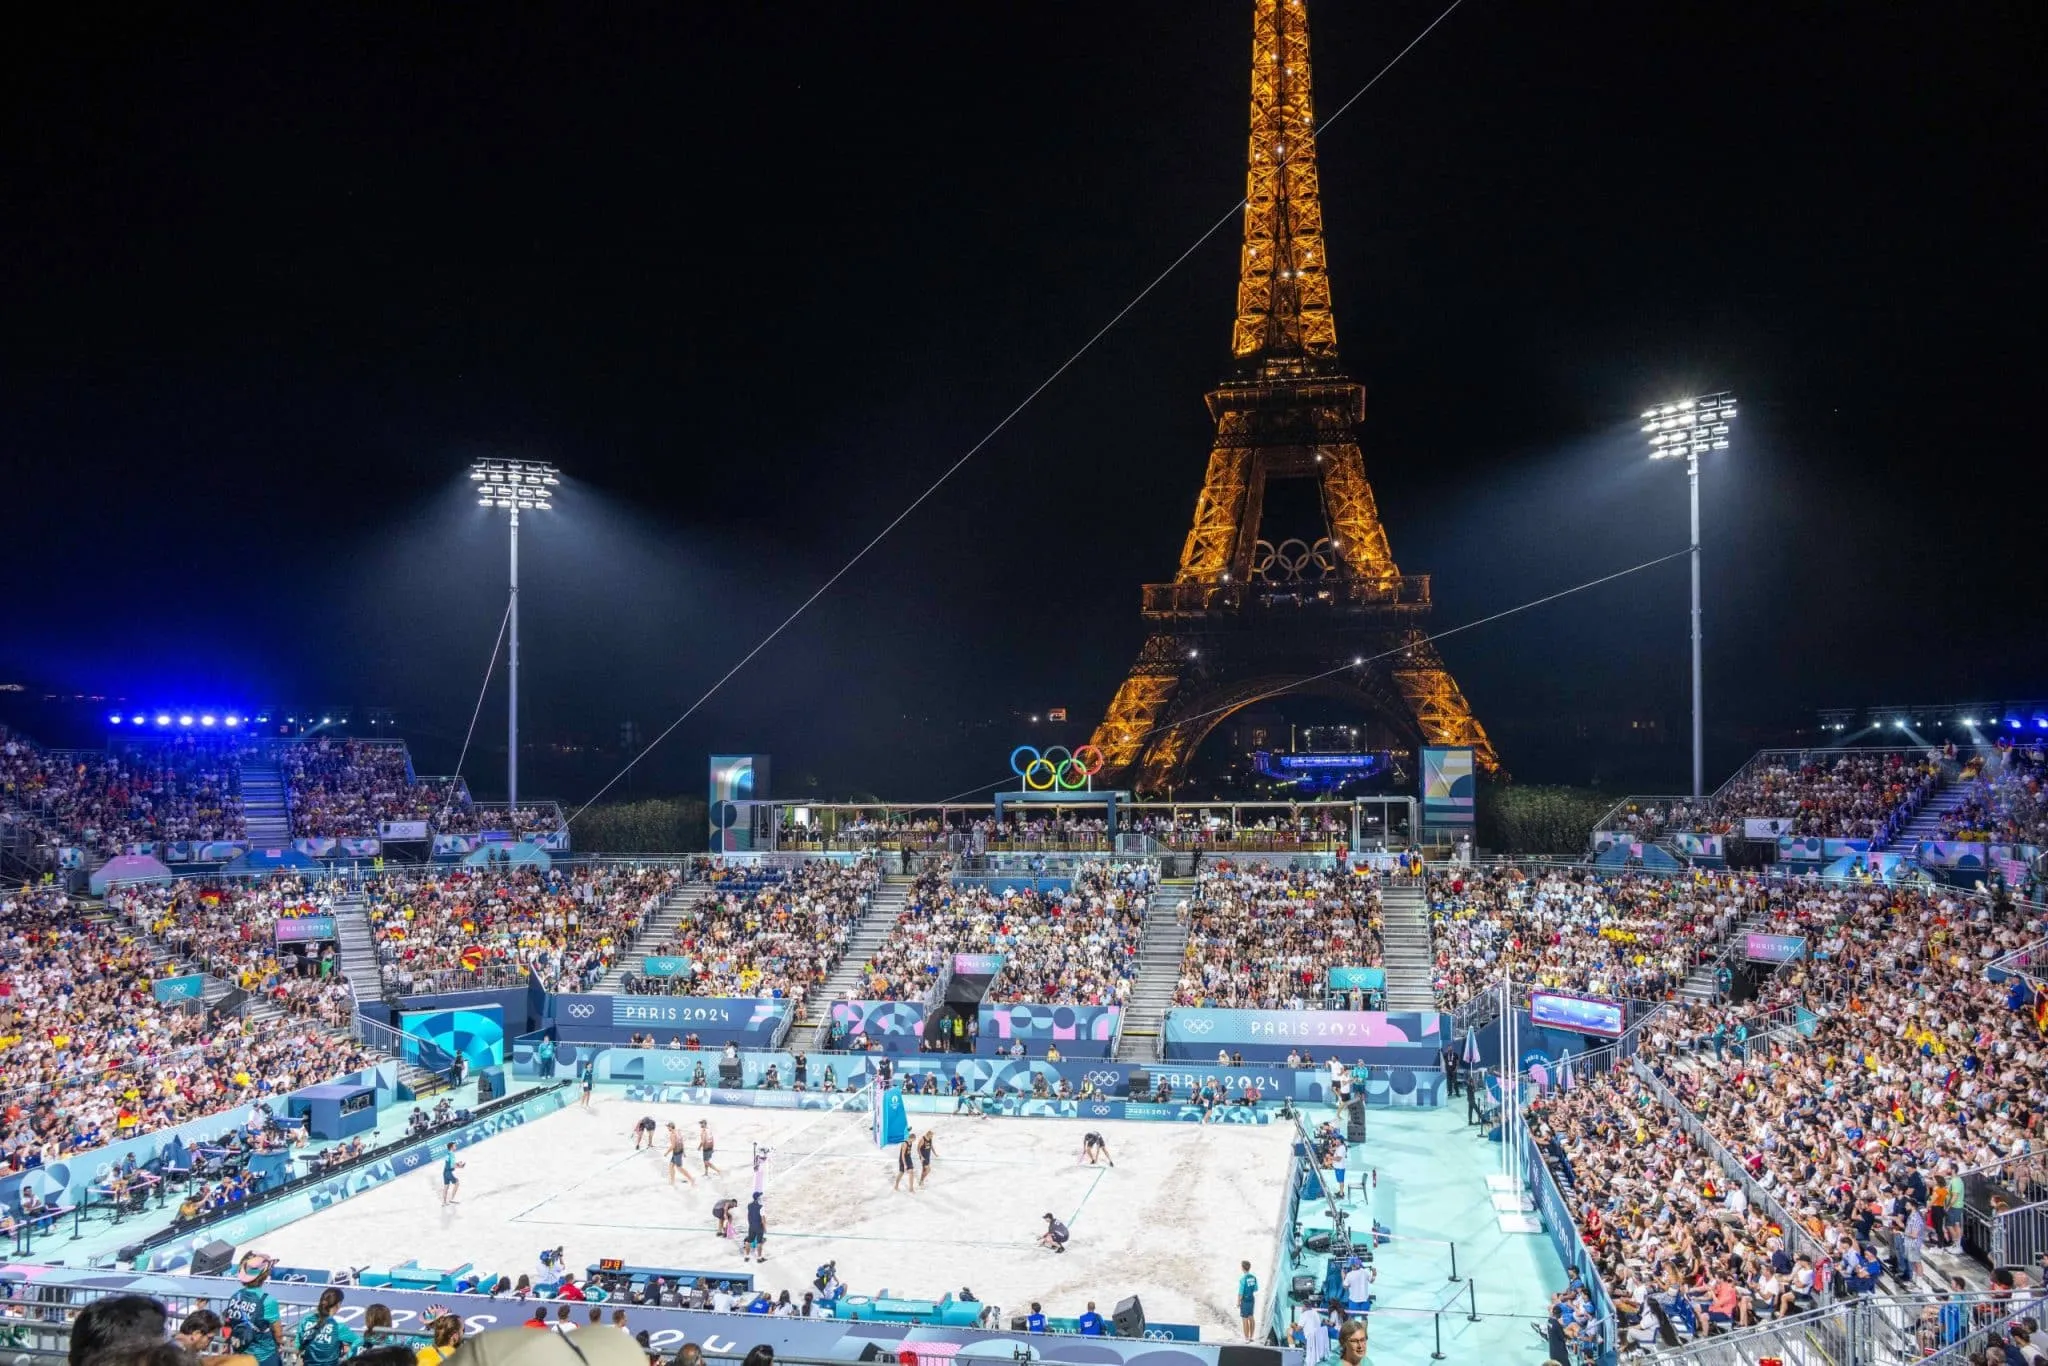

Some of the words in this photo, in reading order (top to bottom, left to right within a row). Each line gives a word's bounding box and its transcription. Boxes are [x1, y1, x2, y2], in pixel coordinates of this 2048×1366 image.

[626, 1006, 677, 1020] PARIS
[683, 1007, 729, 1022] 2024
[1251, 1020, 1309, 1035] PARIS
[1318, 1021, 1370, 1036] 2024
[1225, 1076, 1279, 1090] 2024
[229, 1299, 257, 1314] PARIS
